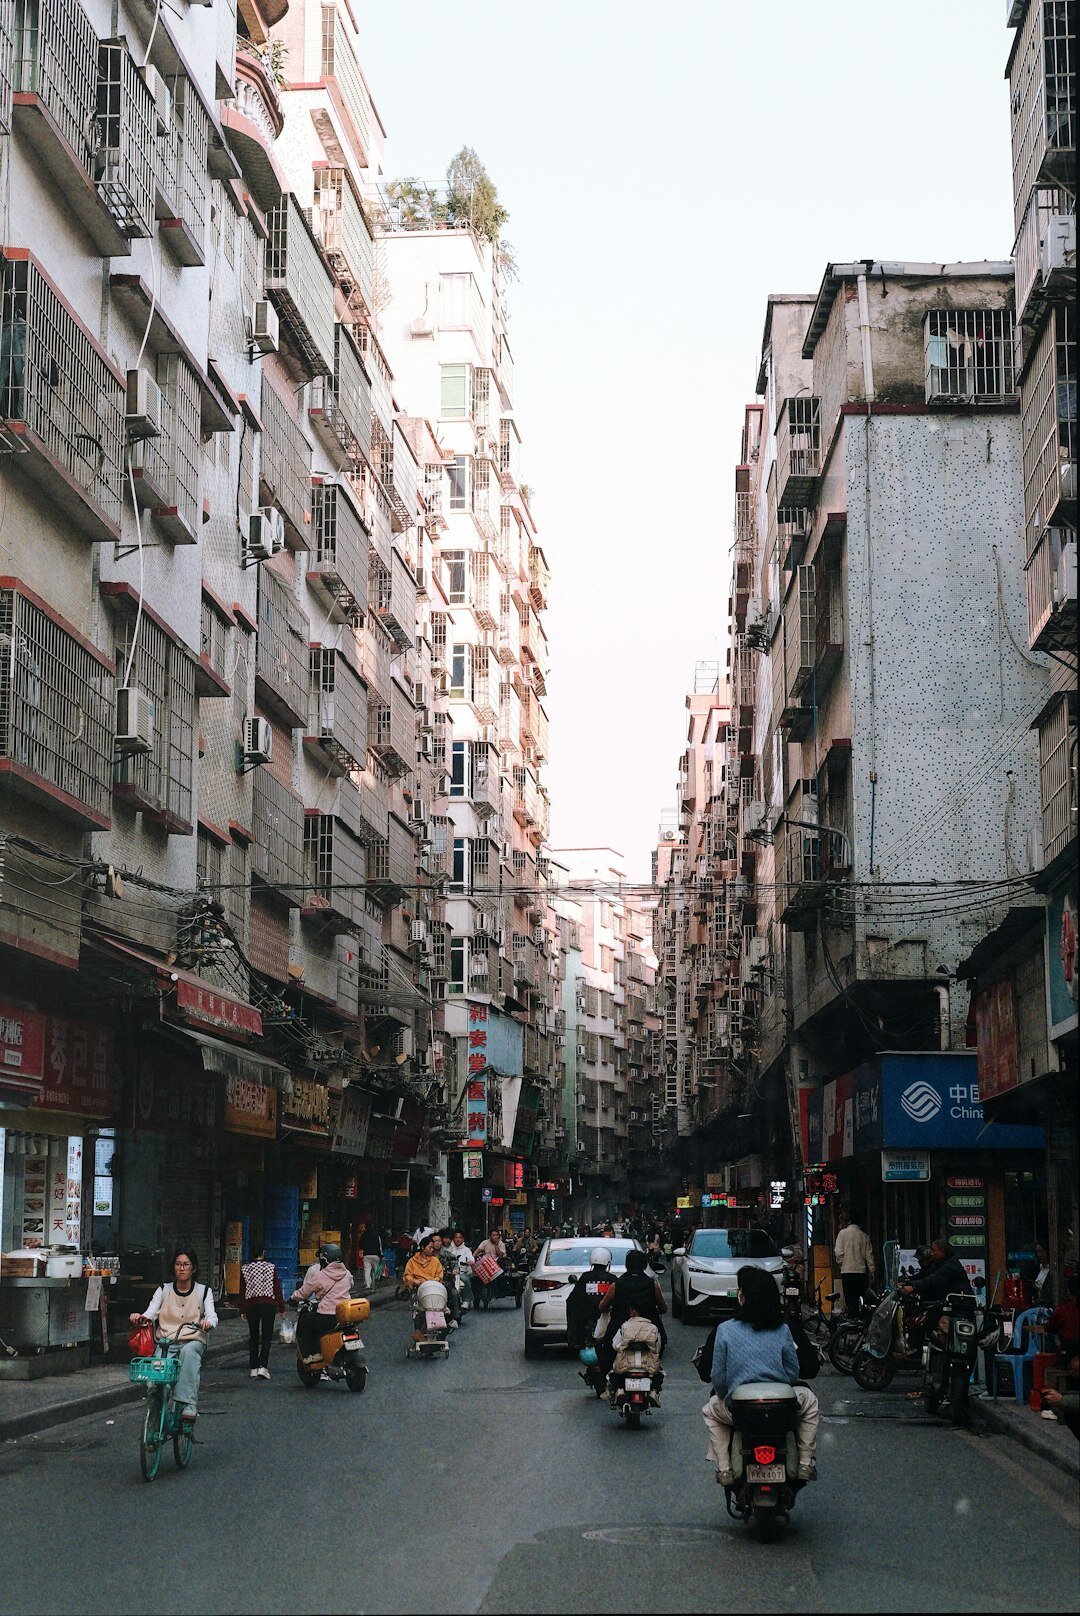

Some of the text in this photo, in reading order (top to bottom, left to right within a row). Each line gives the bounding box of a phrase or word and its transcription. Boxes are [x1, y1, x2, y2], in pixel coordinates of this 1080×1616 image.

[468, 1004, 487, 1131] 和安堂医药
[53, 1173, 66, 1231] 美好一天
